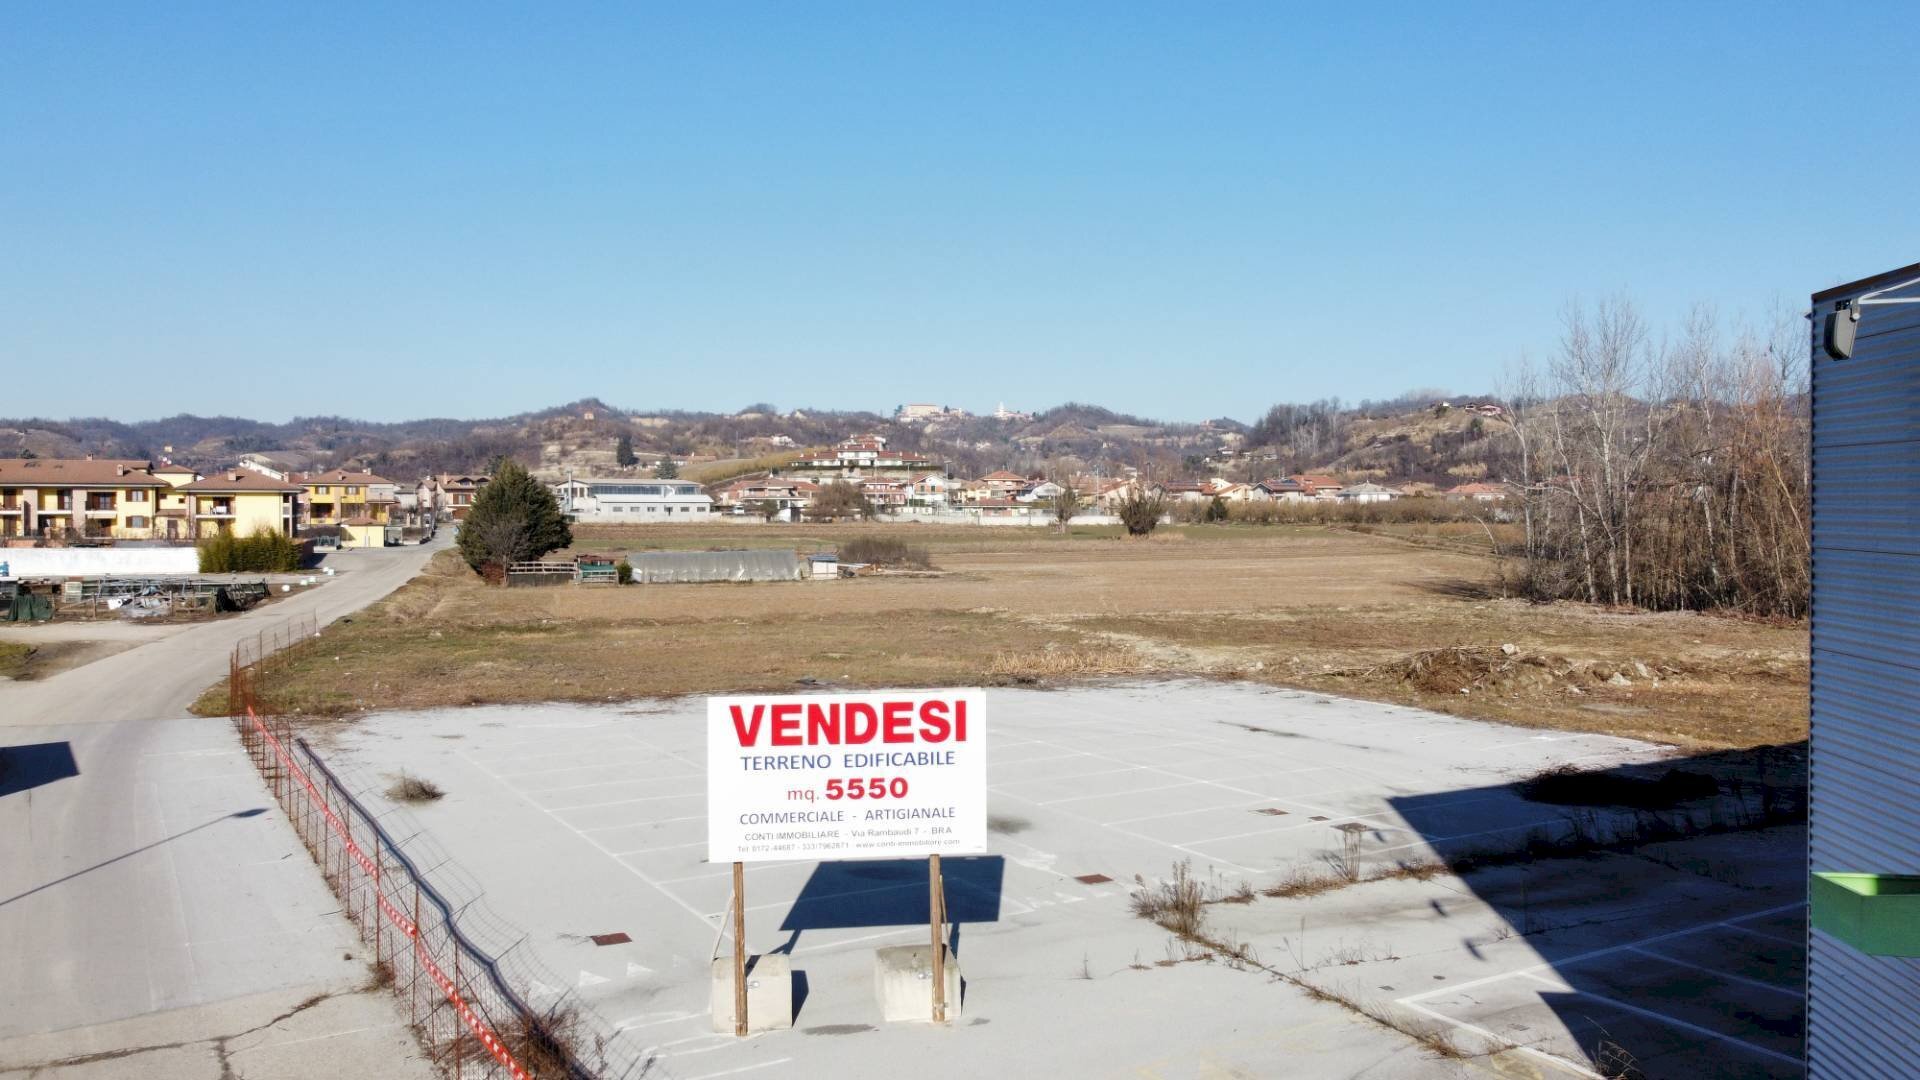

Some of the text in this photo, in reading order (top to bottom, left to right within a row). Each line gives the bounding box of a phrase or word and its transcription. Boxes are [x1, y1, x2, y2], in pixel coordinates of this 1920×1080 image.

[729, 700, 967, 747] VENDESI
[740, 751, 956, 771] TERRENO EDIFICABILE
[787, 777, 909, 803] mq. 5550
[740, 810, 845, 825] COMMERCIALE
[865, 807, 956, 820] ARTIGIANALE
[851, 829, 865, 837] Via
[868, 828, 912, 837] Rambaudi
[931, 826, 953, 835] BRA
